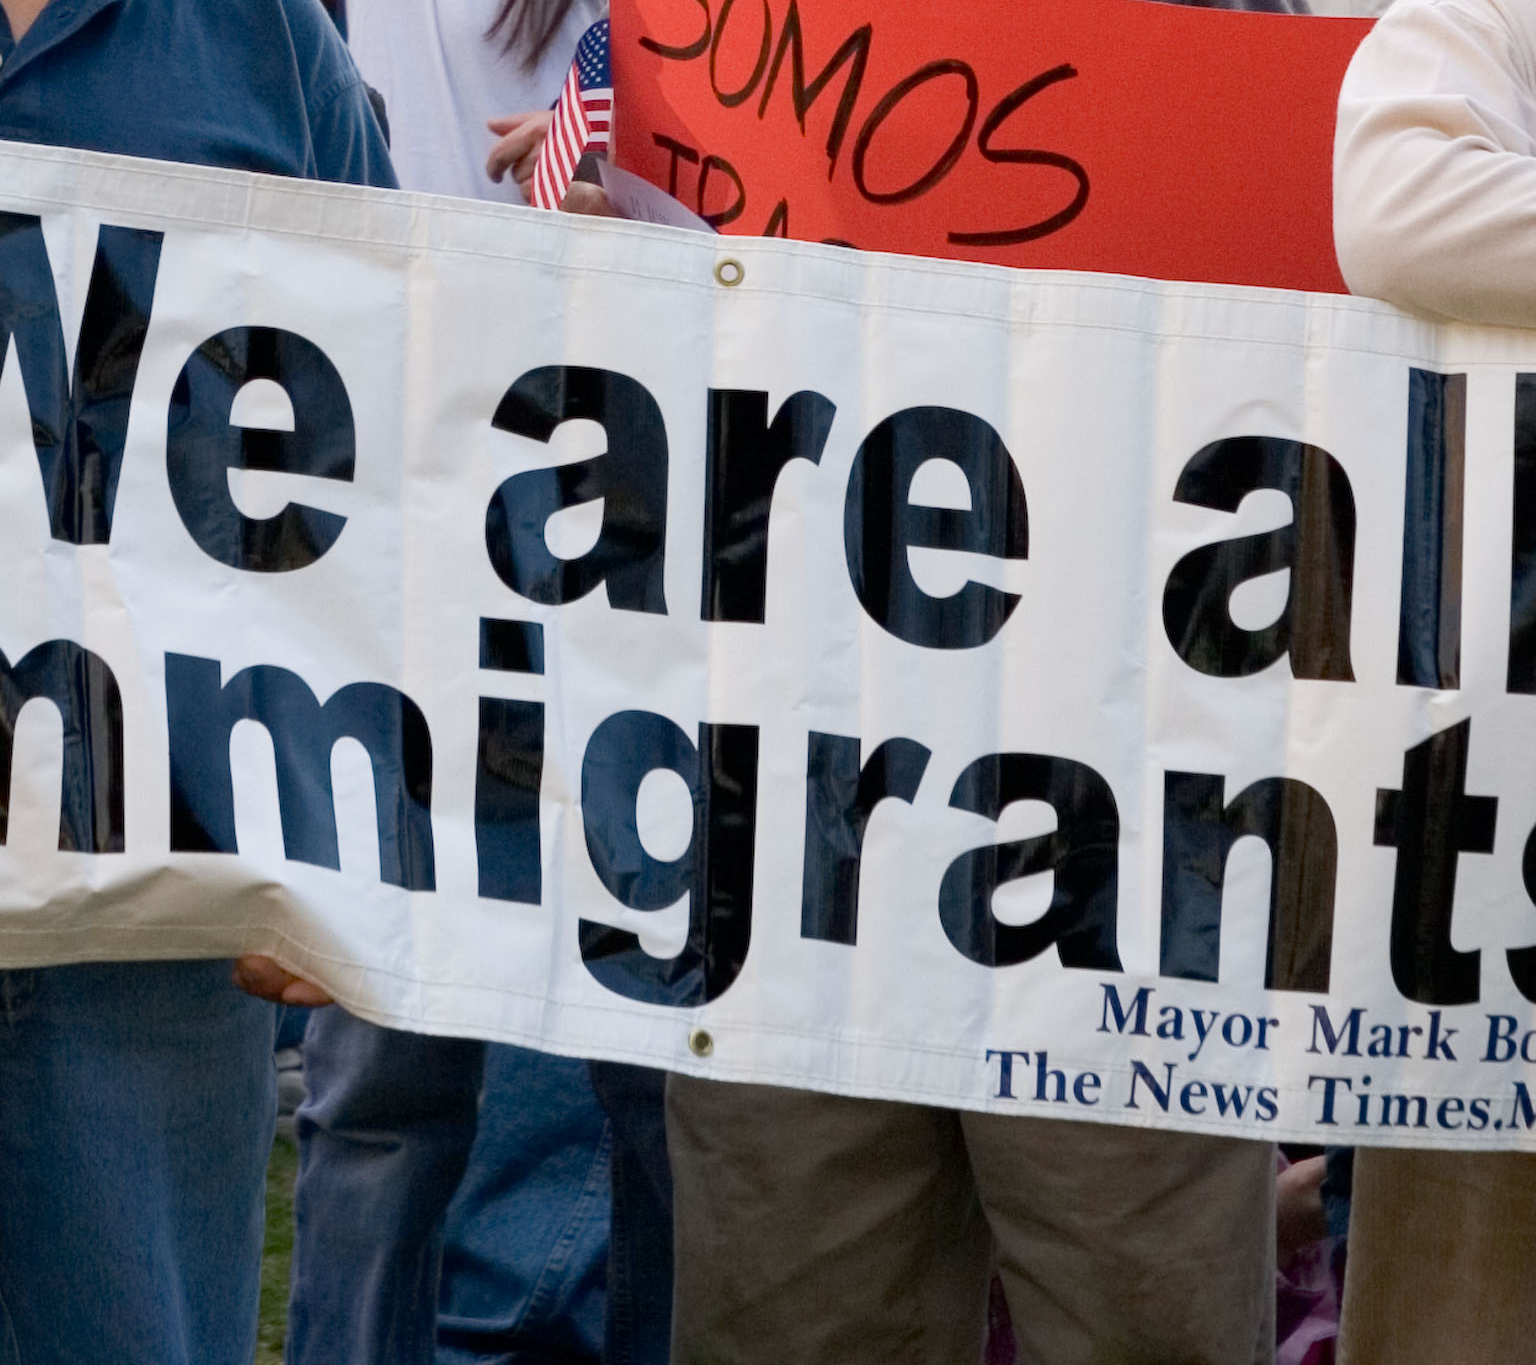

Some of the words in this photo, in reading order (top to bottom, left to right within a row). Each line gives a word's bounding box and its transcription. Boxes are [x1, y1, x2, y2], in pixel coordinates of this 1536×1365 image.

[486, 366, 1029, 649] are
[1099, 984, 1278, 1060] Mayor
[1310, 1006, 1456, 1060] Mark
[986, 1050, 1101, 1104] The
[1126, 1061, 1277, 1120] News
